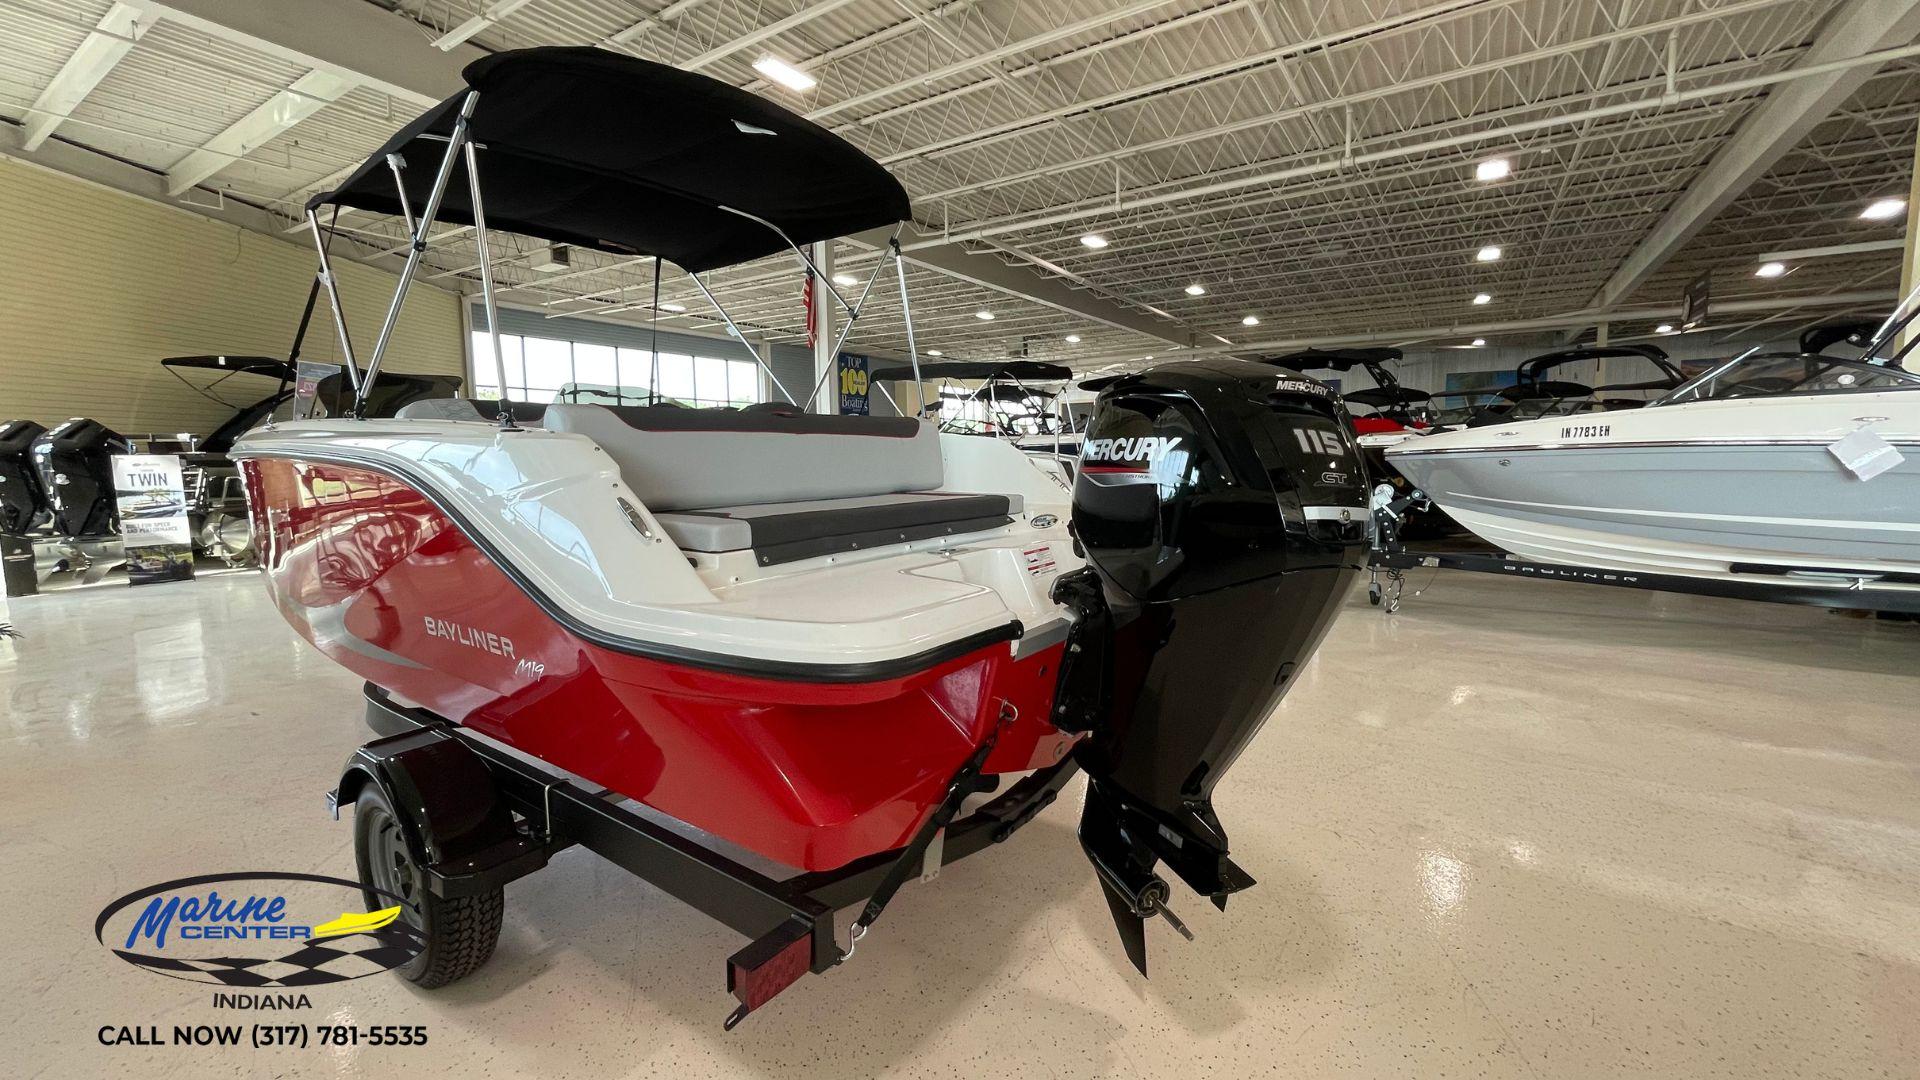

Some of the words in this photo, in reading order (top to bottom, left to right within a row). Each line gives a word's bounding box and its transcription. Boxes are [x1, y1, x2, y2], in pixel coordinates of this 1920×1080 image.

[847, 356, 862, 368] TOP
[840, 367, 867, 395] 100
[1276, 380, 1329, 396] MERCURY
[1293, 428, 1345, 456] 115
[1561, 427, 1571, 438] IN
[1573, 426, 1597, 438] 7783
[127, 473, 168, 487] TWIN
[424, 616, 516, 660] BAYLINER
[515, 658, 545, 682] M19
